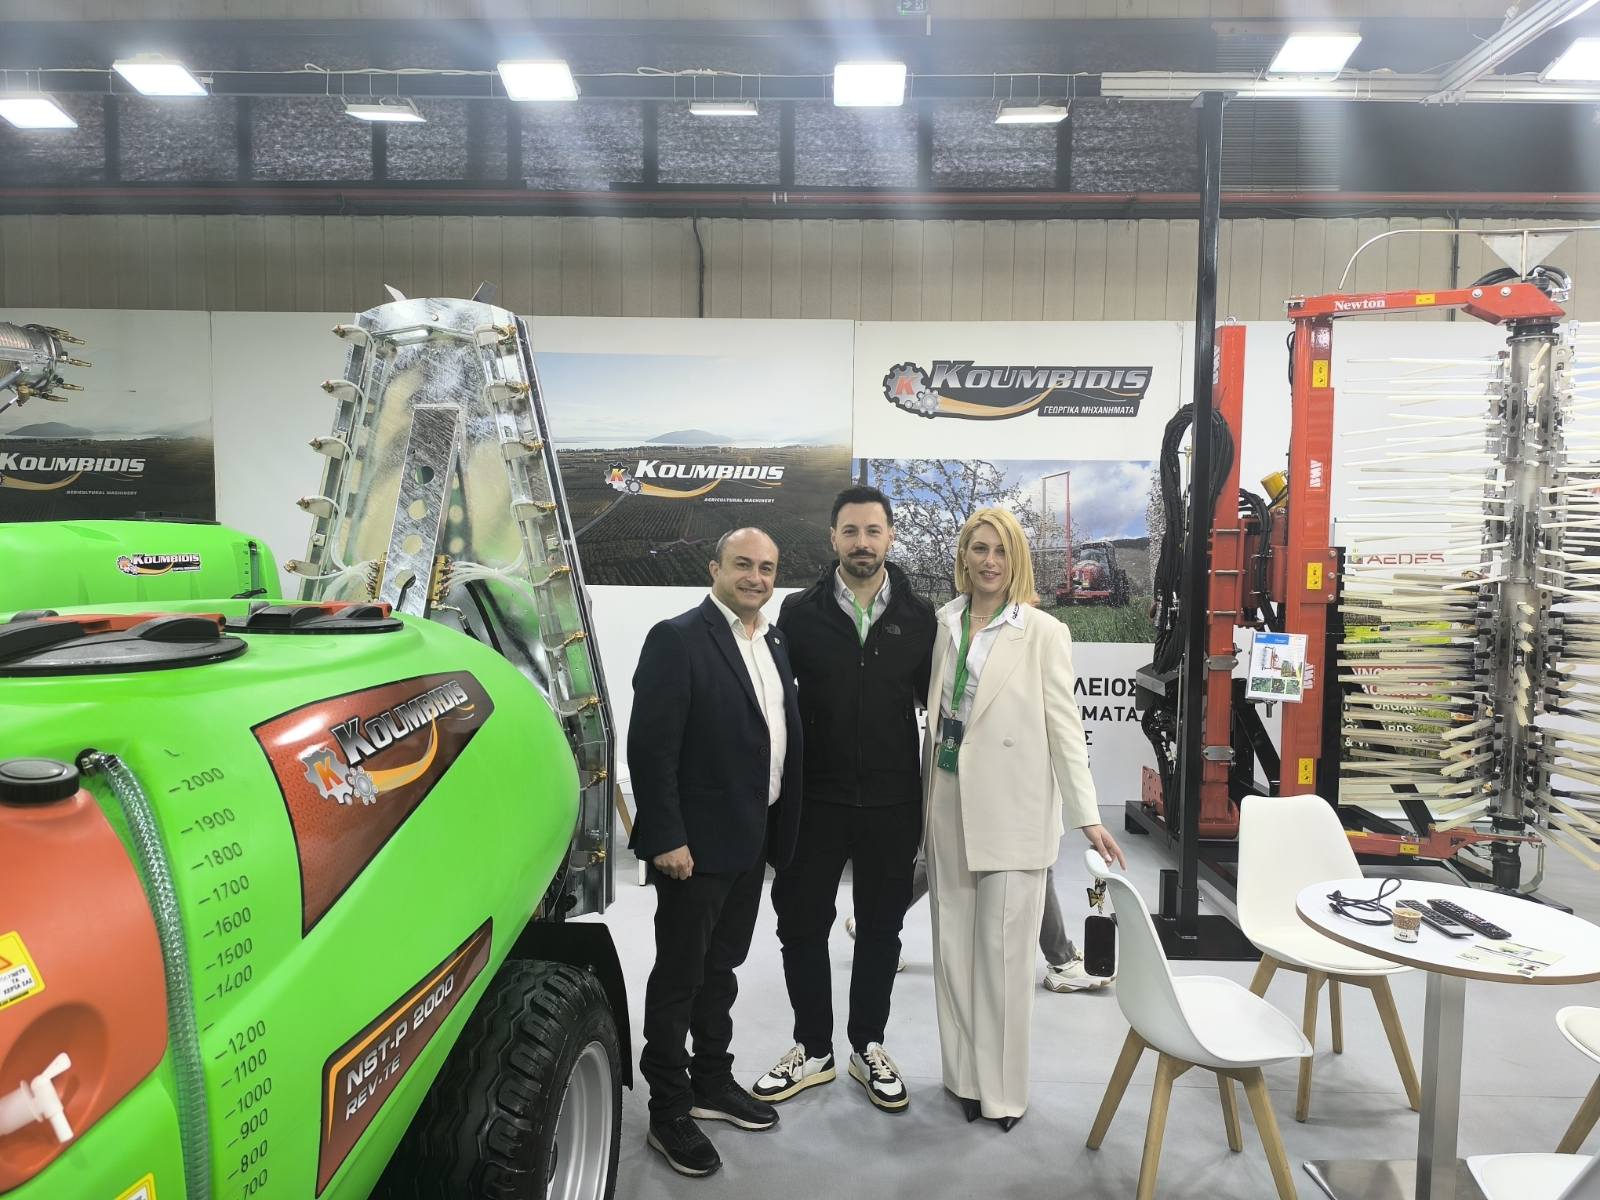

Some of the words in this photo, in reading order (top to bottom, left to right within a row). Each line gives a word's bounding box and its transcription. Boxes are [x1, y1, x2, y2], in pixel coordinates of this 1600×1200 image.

[1334, 300, 1386, 311] Newton
[895, 375, 914, 396] K
[931, 363, 1148, 390] KOUMBIDIS
[1043, 405, 1079, 414] ΓΕΩΡΓΙΚΑ
[1081, 406, 1134, 415] ΜΗΧΑΝΗΜΑΤΑ
[0, 452, 146, 472] KOUMBIDIS
[609, 468, 625, 482] K
[634, 459, 785, 480] KOUMBIDIS
[132, 554, 200, 564] KOUMBIDIS
[331, 680, 469, 765] KOUMBIDIS
[1077, 705, 1139, 722] ΜΑΤΑ
[182, 767, 224, 791] 2000
[313, 757, 343, 792] K
[194, 808, 235, 832] 1900
[204, 842, 243, 868] 1800
[213, 875, 249, 902] 1700
[216, 907, 252, 937] 1600
[217, 938, 252, 967] 1500
[217, 965, 252, 998] 1400
[229, 1020, 265, 1054] 1200
[347, 1020, 408, 1095] NST-P
[413, 974, 454, 1030] 2000
[234, 1048, 267, 1082] 1100
[238, 1077, 271, 1112] 1000
[241, 1108, 267, 1139] 900
[241, 1140, 267, 1173] 800
[243, 1169, 267, 1200] 700
